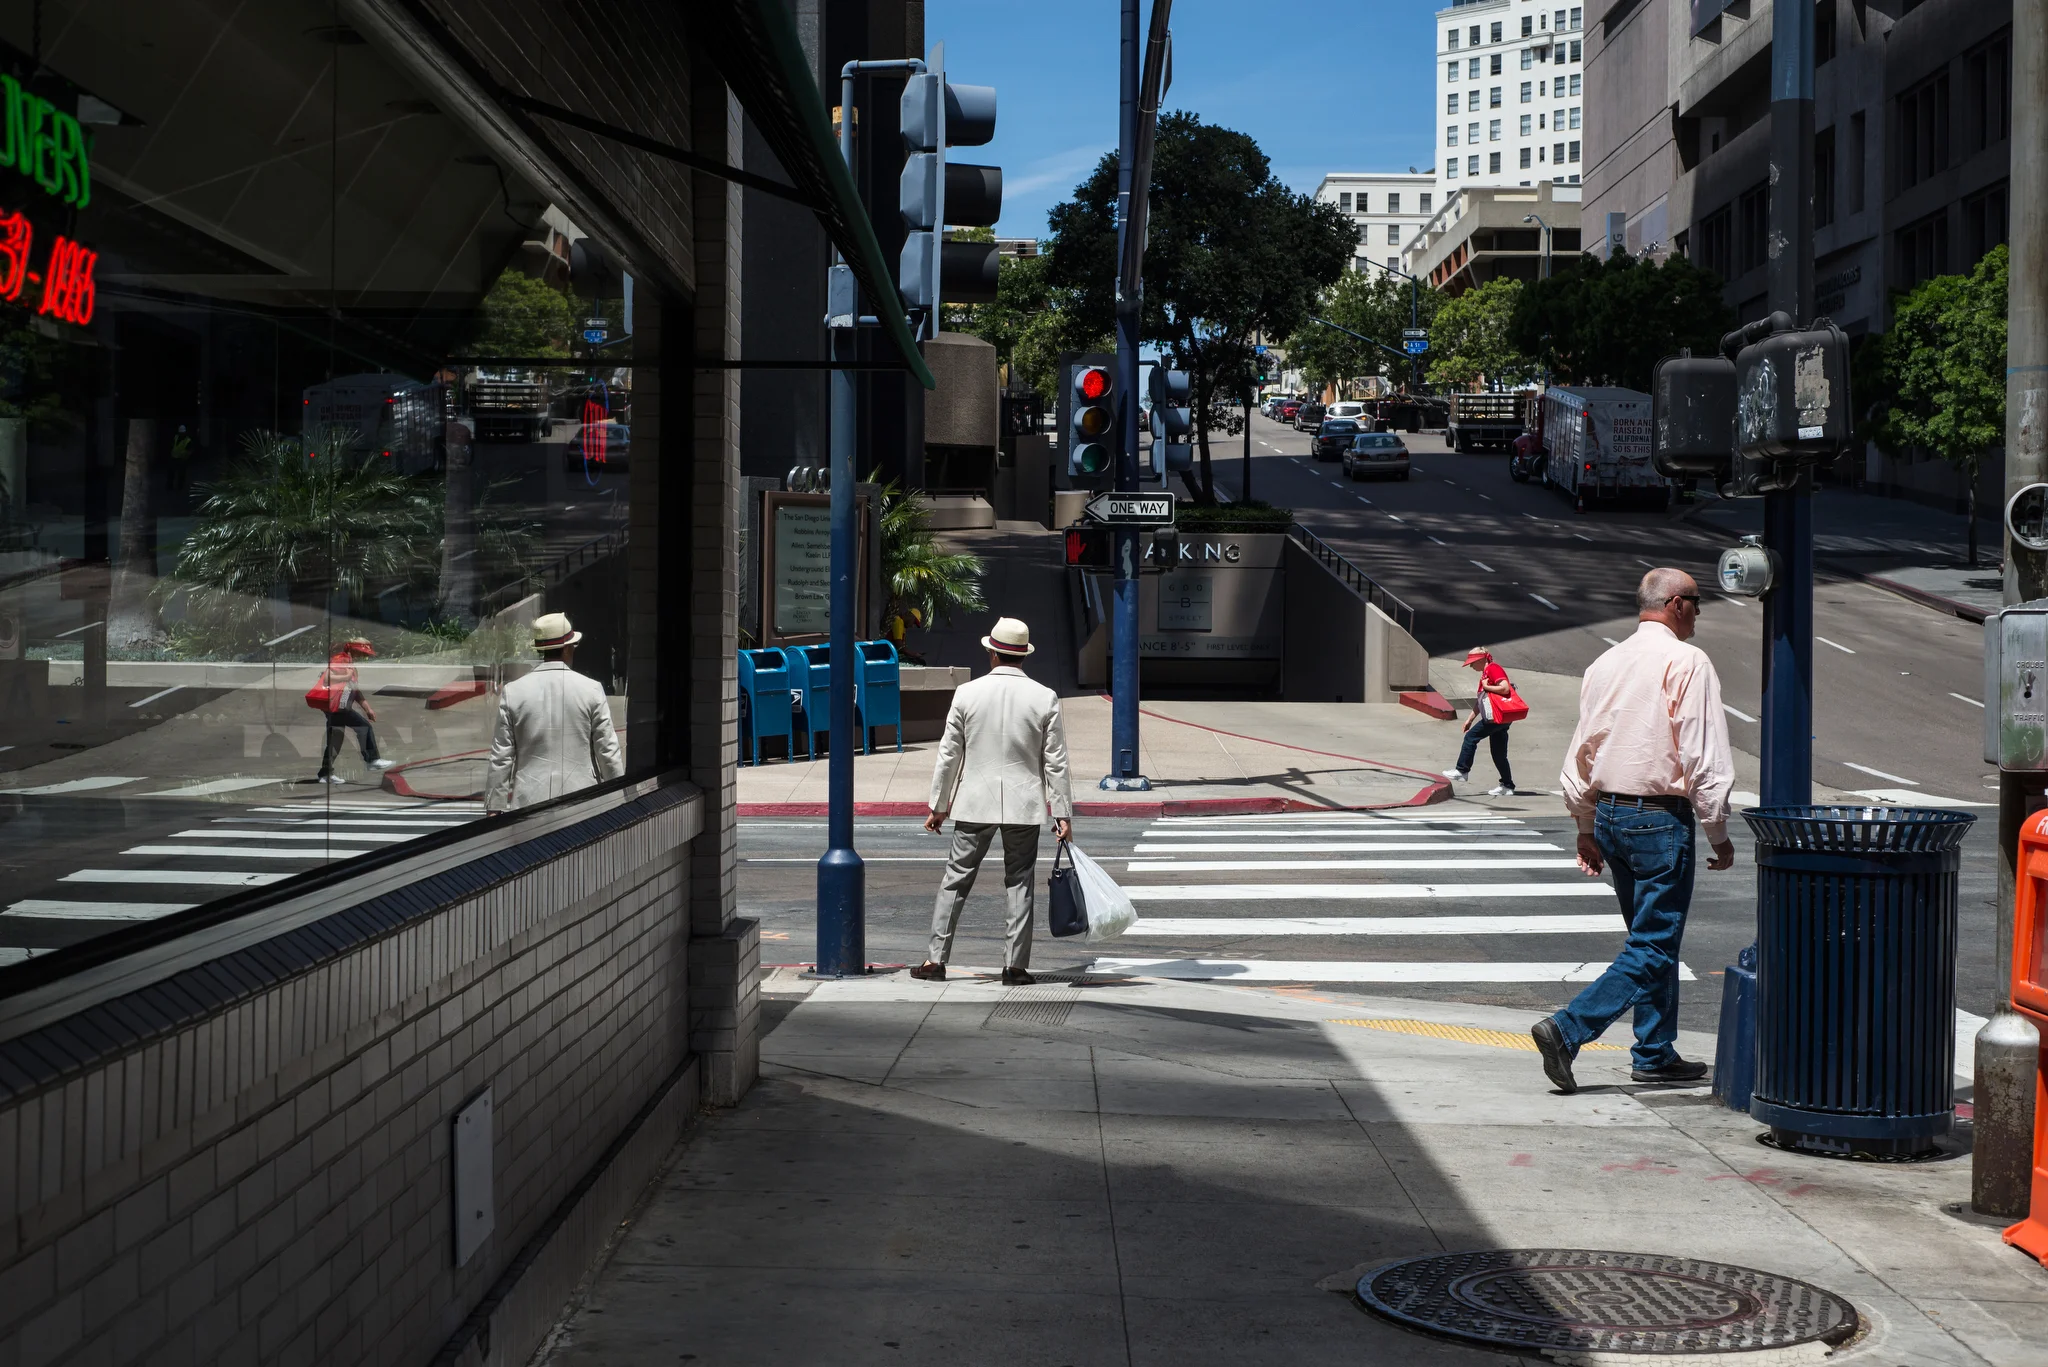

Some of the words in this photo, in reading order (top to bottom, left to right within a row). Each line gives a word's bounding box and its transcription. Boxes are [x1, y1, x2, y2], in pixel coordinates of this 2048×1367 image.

[1613, 418, 1635, 426] BORN
[1613, 427, 1642, 435] RAISED
[1110, 502, 1135, 514] ONE
[1139, 502, 1165, 514] WAY
[783, 513, 794, 521] The
[804, 514, 819, 523] Diego
[790, 565, 824, 573] Underground
[787, 579, 808, 587] Rudolph
[1180, 597, 1191, 608] B
[1206, 643, 1225, 651] FIRST
[1227, 643, 1249, 651] LEVEL
[2015, 660, 2045, 669] CROUSE
[2013, 713, 2045, 722] TRAFFIC
